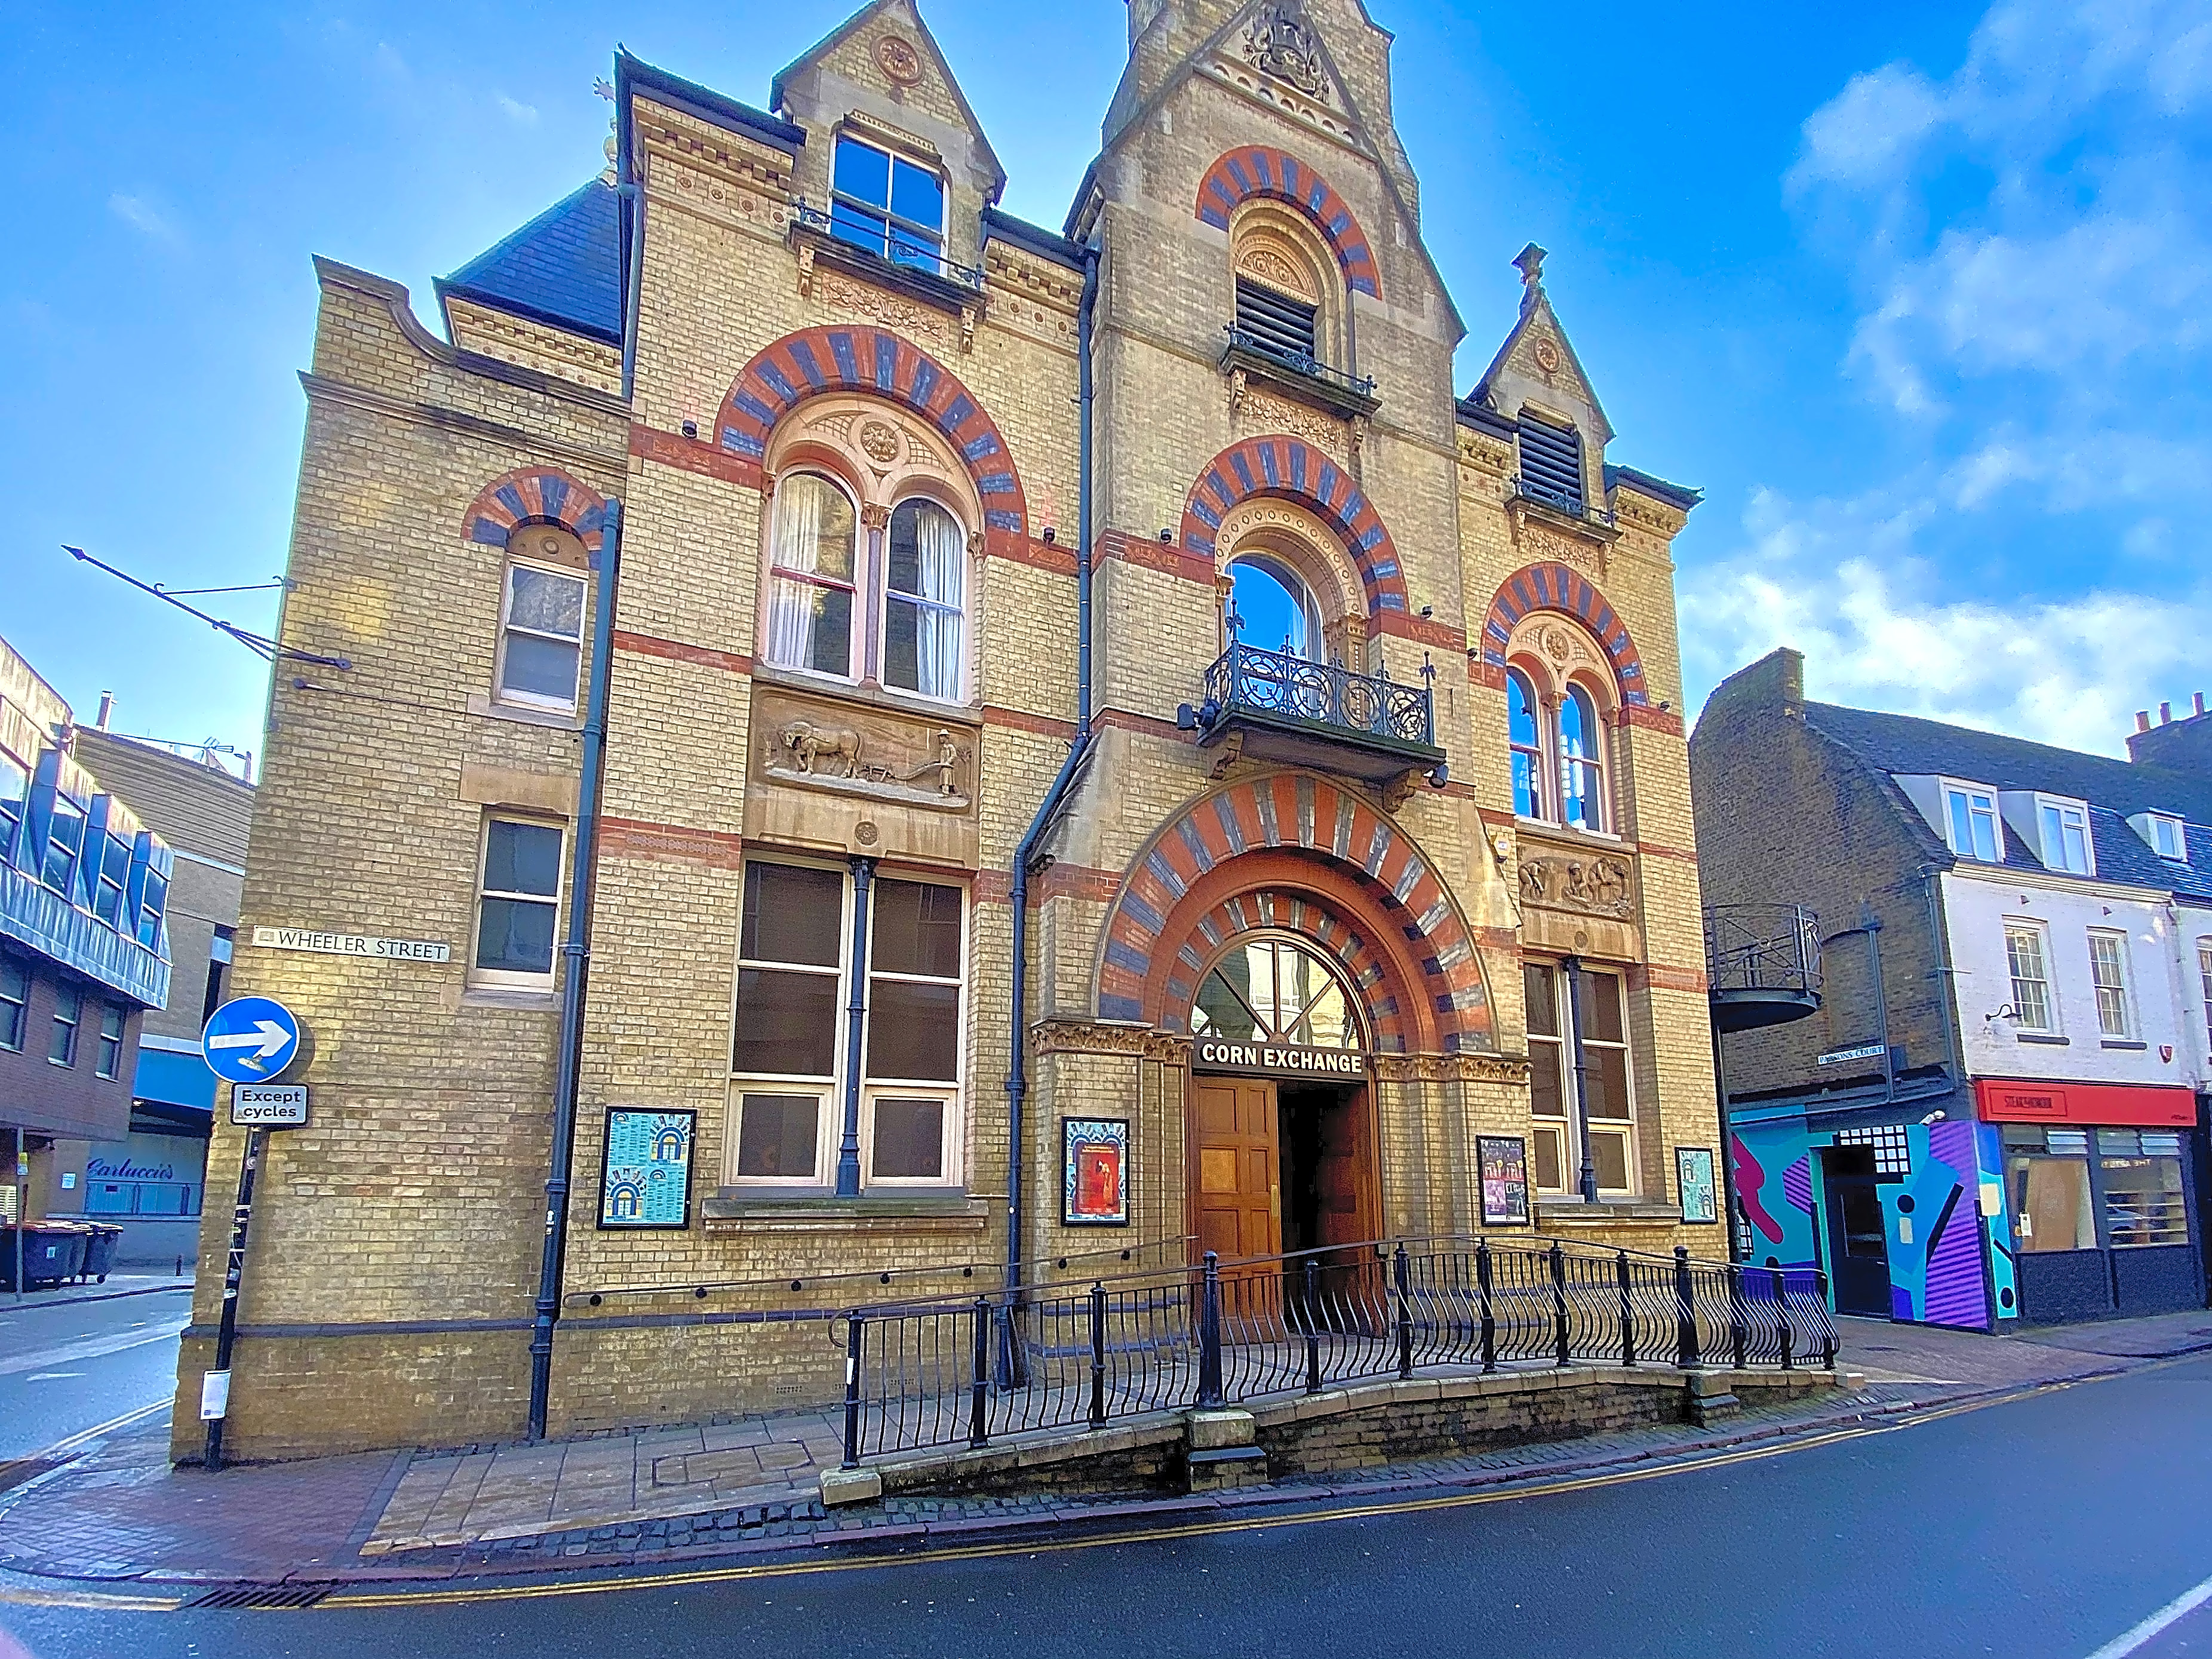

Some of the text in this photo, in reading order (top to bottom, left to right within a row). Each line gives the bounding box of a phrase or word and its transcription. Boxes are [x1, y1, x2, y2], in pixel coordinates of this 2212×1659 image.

[279, 931, 446, 959] WHEELER STREET
[1202, 1043, 1363, 1073] CORN EXCHANGE
[1855, 1046, 1882, 1057] COURT
[241, 1090, 302, 1109] Except
[243, 1104, 297, 1118] cycles
